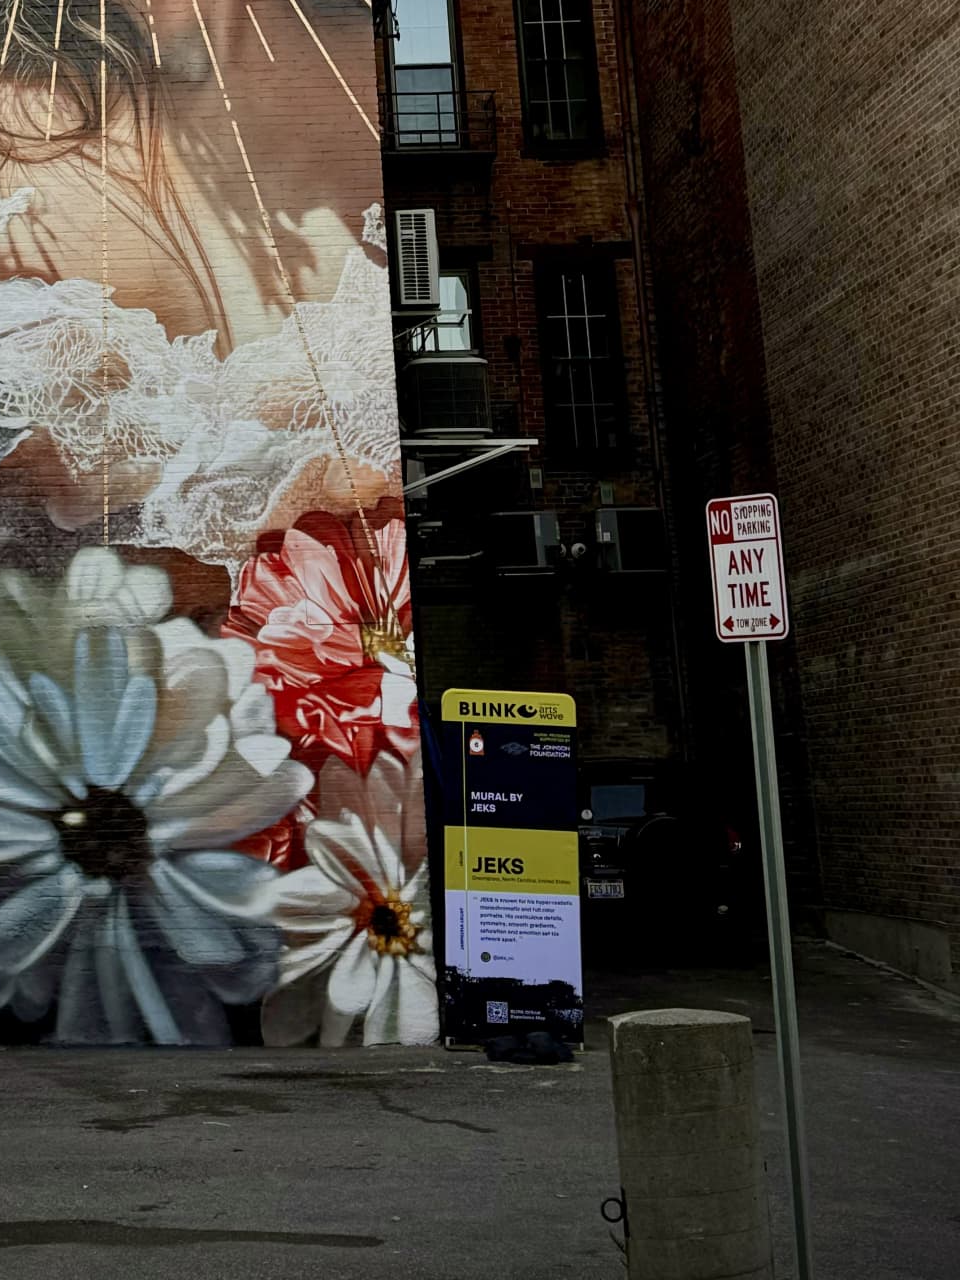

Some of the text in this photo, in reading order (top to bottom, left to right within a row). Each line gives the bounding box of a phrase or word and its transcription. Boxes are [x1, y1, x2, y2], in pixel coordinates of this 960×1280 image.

[734, 504, 772, 520] STOPPING
[710, 510, 730, 536] NO
[737, 520, 771, 536] PARKING
[728, 548, 764, 576] ANY
[728, 582, 772, 608] TIME
[736, 617, 768, 628] TOW ZONE
[459, 701, 516, 718] BLINK
[471, 792, 523, 802] MURAL BY
[471, 804, 496, 813] JEKS
[472, 856, 524, 874] JEKS
